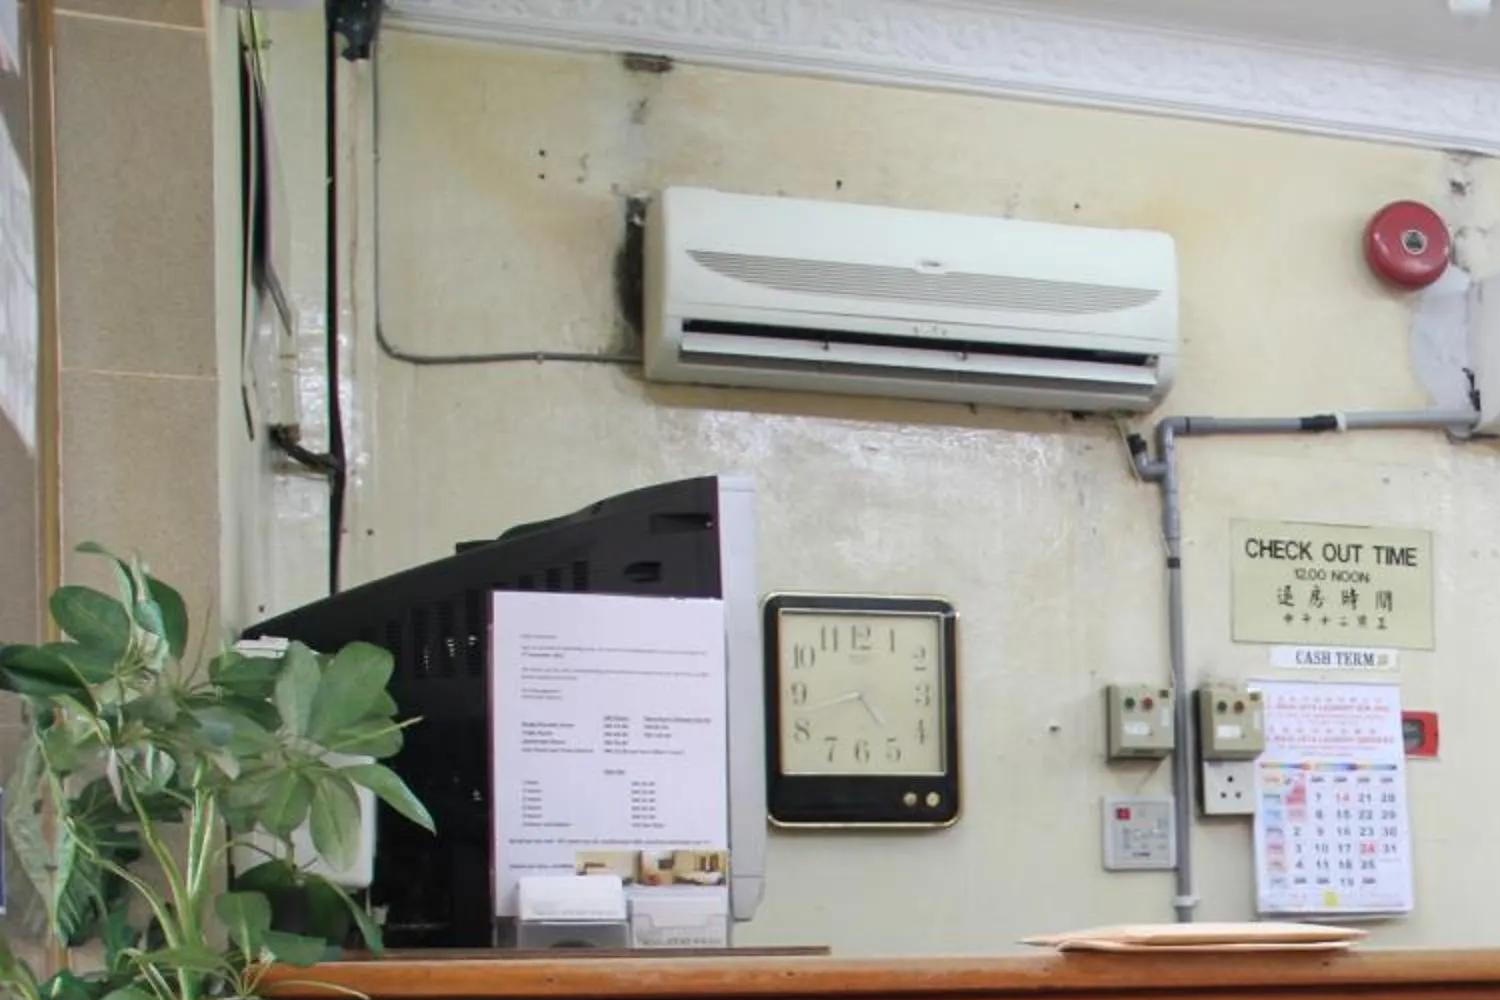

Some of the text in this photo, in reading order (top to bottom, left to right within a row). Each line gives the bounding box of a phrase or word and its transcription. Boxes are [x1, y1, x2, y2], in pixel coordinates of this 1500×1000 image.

[1245, 537, 1418, 567] CHECK OUT TIME
[1331, 569, 1370, 584] NOON
[820, 624, 838, 652] 11
[850, 624, 873, 651] 12
[889, 627, 896, 654] 1
[792, 642, 816, 670] 10
[912, 645, 928, 672] 2
[1295, 650, 1332, 665] CASH
[1335, 651, 1375, 666] TERM
[790, 681, 808, 706] 9
[913, 681, 931, 707] 3
[792, 718, 811, 744] 8
[823, 735, 839, 764] 7
[854, 739, 871, 765] 6
[884, 737, 902, 761] 5
